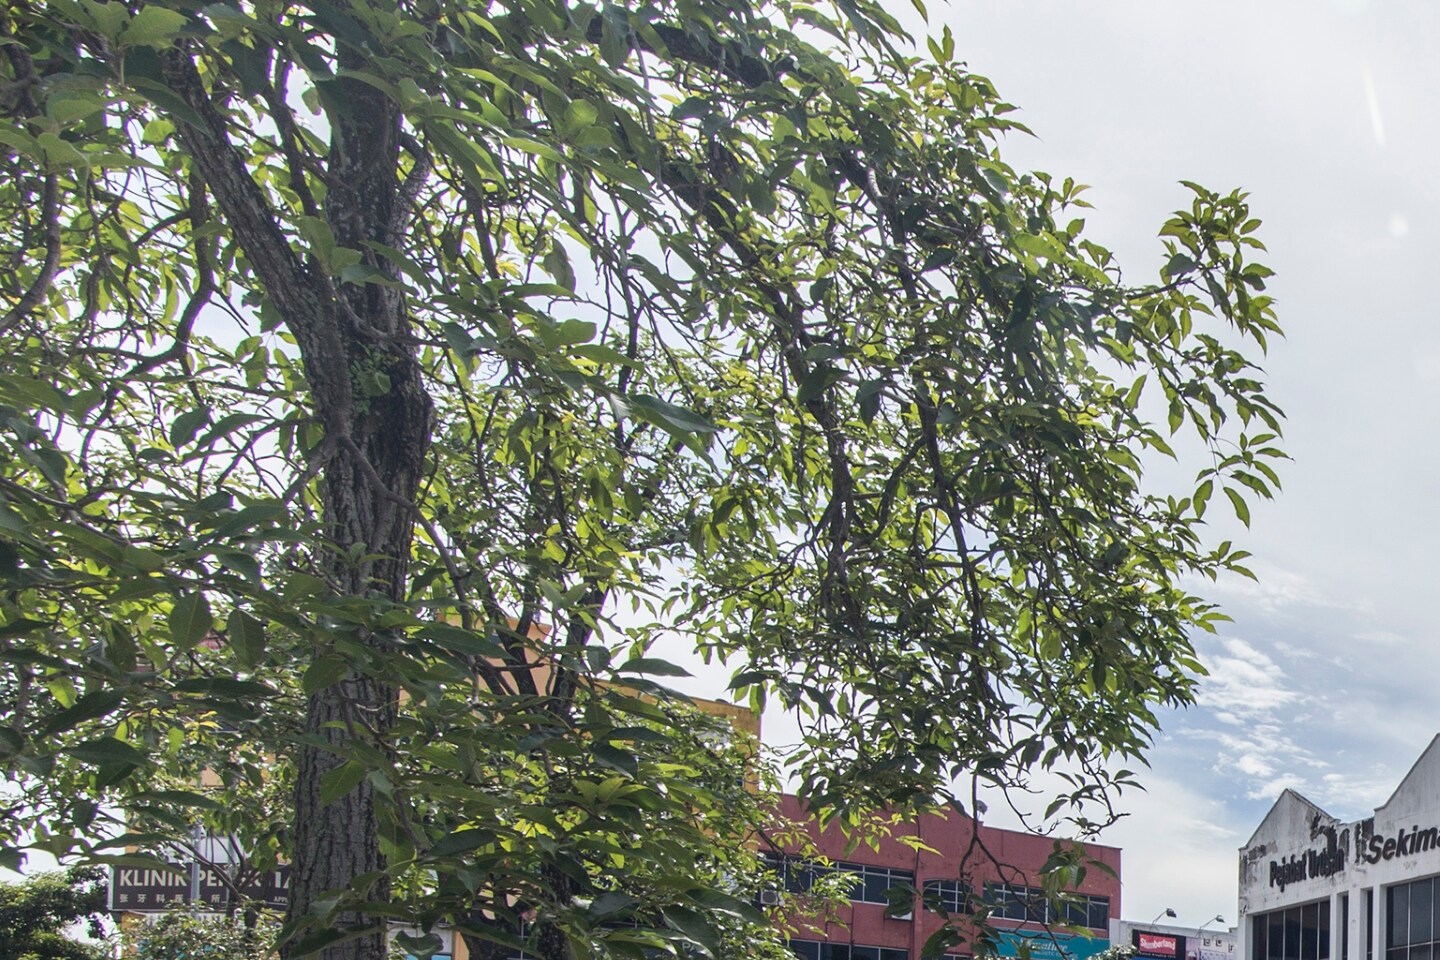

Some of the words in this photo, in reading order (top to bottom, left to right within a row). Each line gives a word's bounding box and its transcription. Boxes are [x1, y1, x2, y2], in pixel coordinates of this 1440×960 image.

[120, 869, 187, 887] KLINIK
[1270, 853, 1306, 892] Pejabat
[1140, 938, 1176, 950] Slumberland
